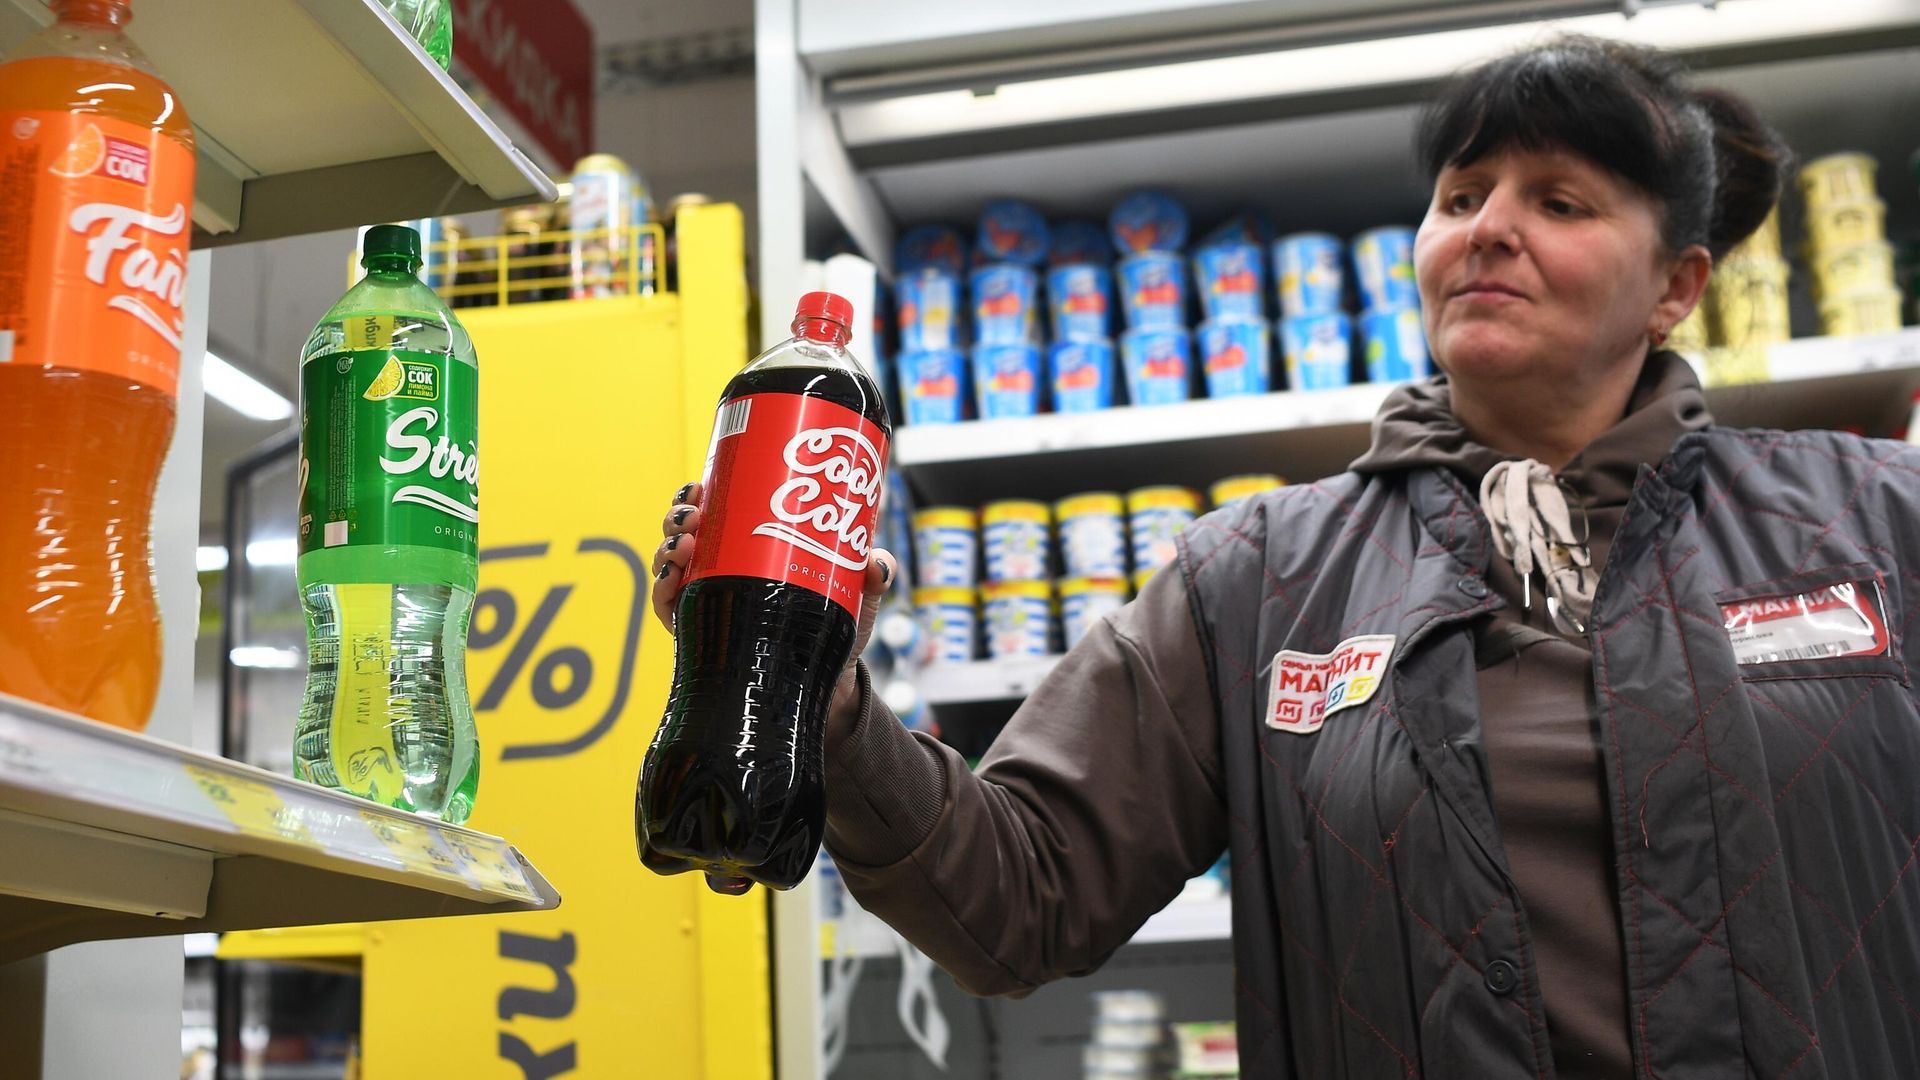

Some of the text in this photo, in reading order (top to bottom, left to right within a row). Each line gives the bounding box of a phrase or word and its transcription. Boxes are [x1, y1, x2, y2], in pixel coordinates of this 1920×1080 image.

[106, 155, 147, 184] СОК
[407, 371, 433, 385] СОК
[783, 427, 883, 507] Cool
[770, 477, 869, 557] Cola
[789, 563, 852, 599] ORIGINAL
[1741, 584, 1853, 618] МАГНИ
[1279, 652, 1382, 693] МАГНИТ
